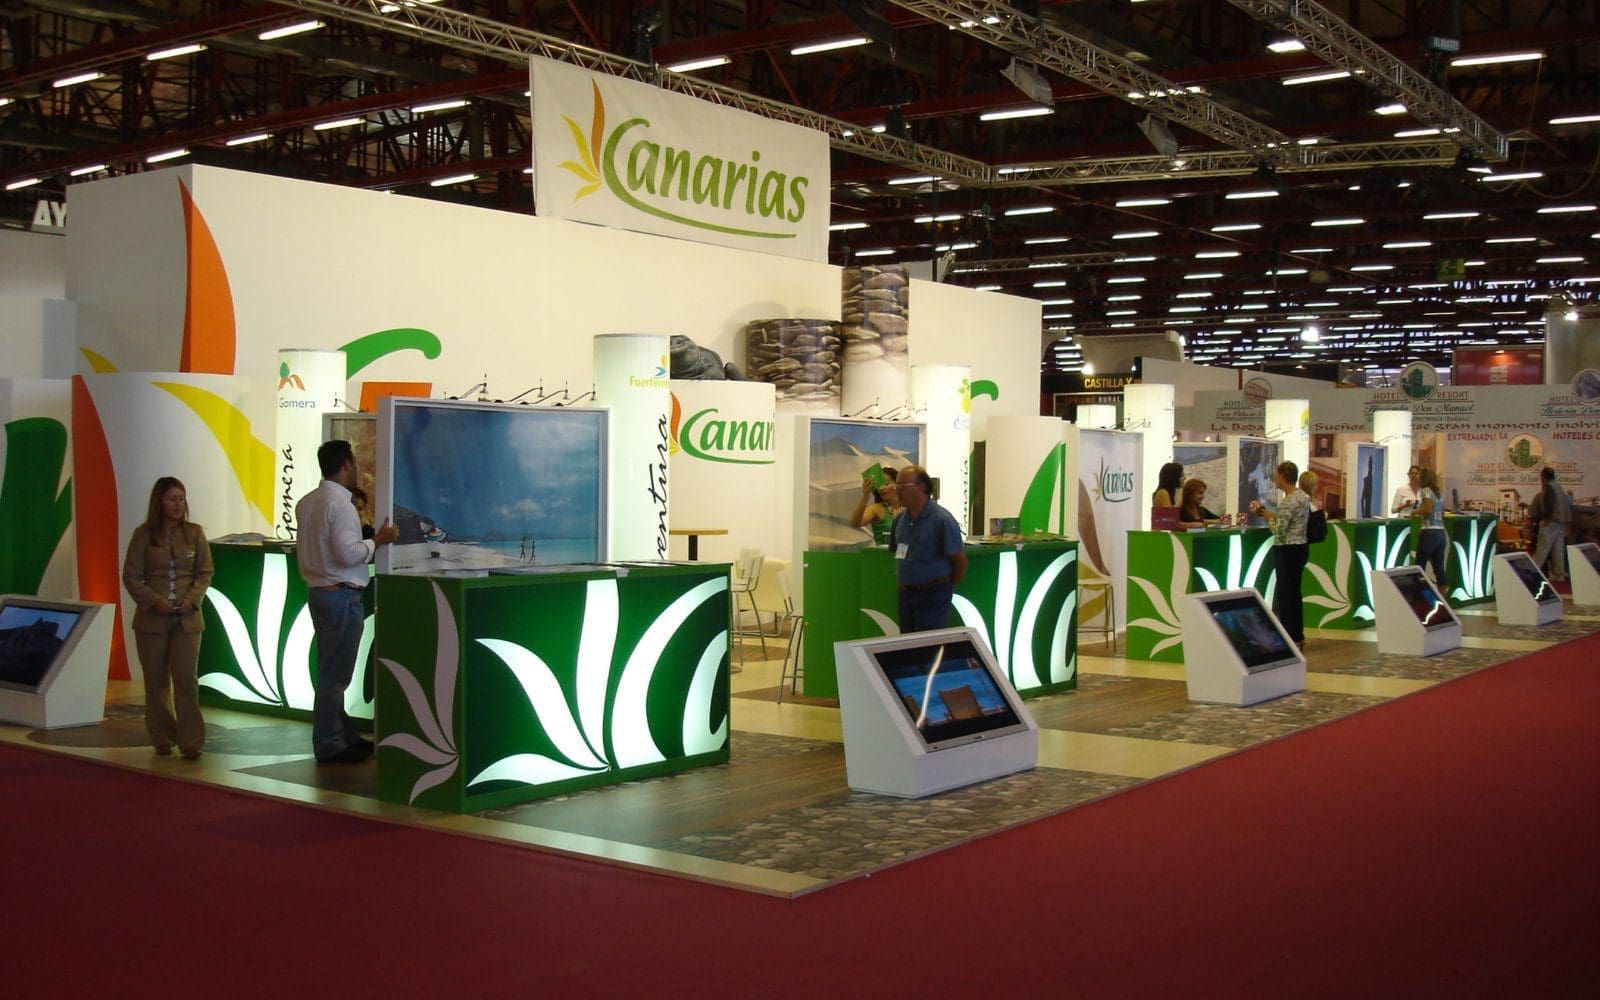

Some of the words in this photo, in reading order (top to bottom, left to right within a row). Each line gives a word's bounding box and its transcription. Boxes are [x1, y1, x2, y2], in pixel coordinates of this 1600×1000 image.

[602, 118, 809, 238] Canarias
[33, 199, 67, 228] AY
[1084, 377, 1123, 389] CASTILLA
[1373, 392, 1400, 400] HOTEL
[1436, 391, 1469, 399] RESORT
[680, 408, 775, 464] Canar
[1552, 431, 1593, 440] HOTELES
